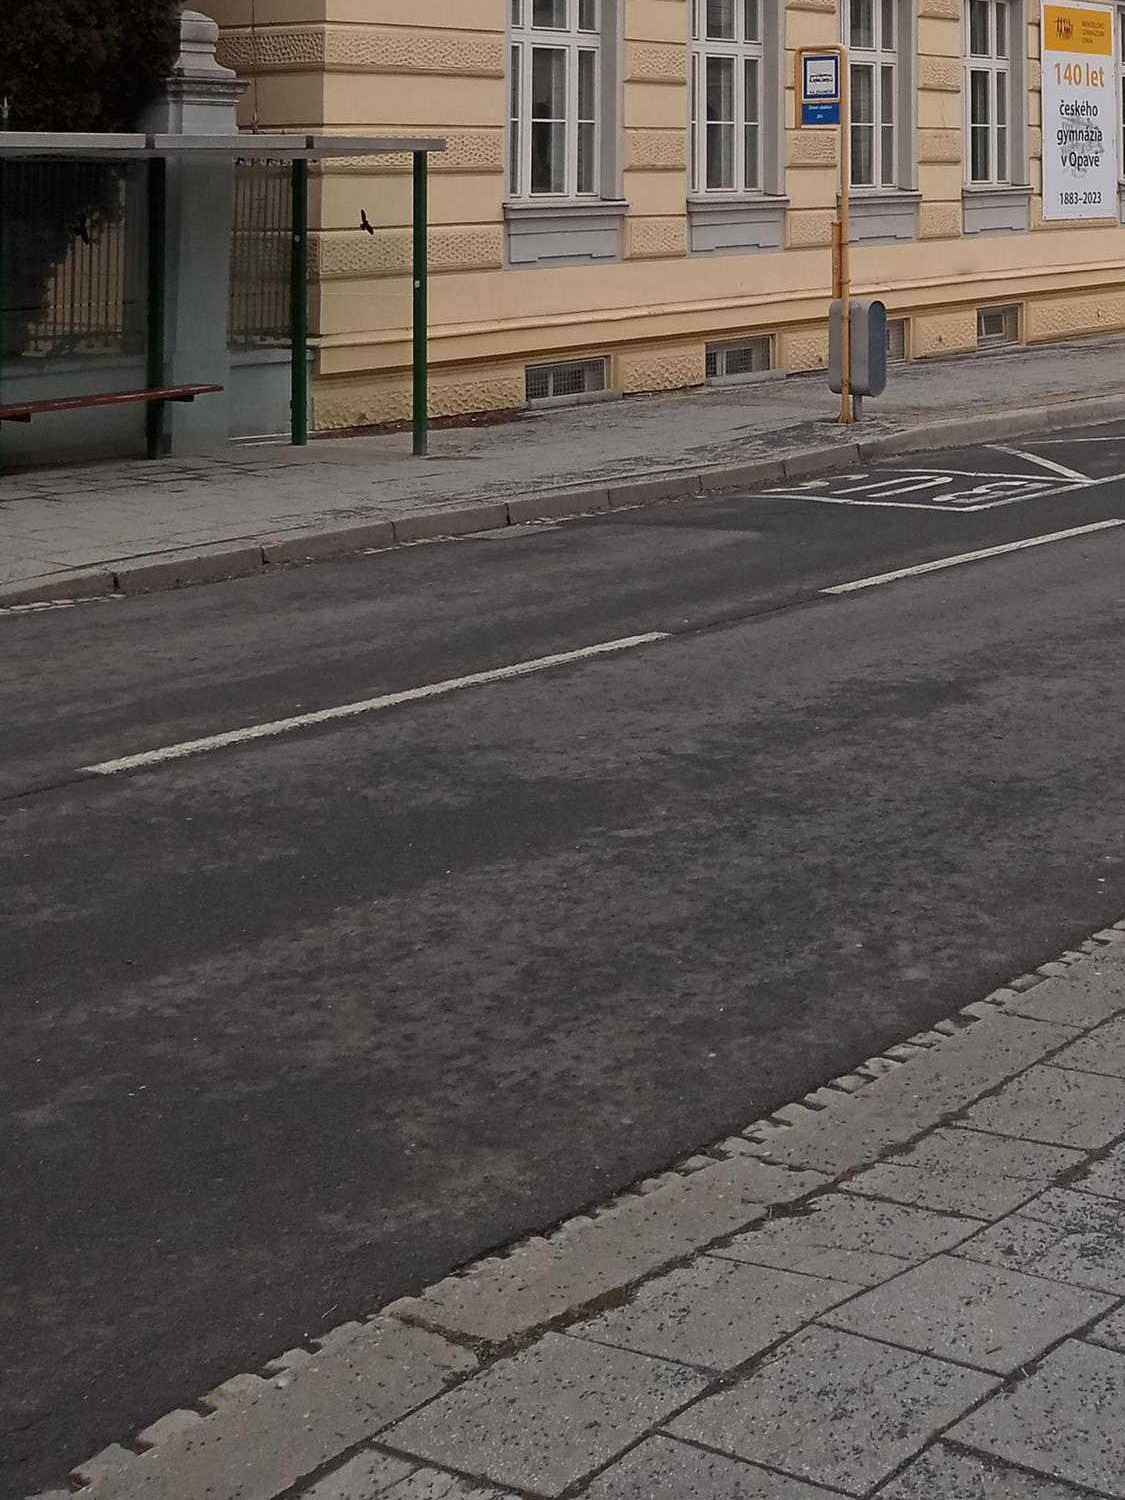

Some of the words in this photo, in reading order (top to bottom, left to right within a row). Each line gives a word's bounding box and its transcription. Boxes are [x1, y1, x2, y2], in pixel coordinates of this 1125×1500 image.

[1055, 62, 1082, 86] 140
[1086, 63, 1105, 87] let
[1059, 100, 1098, 117] českého
[1056, 126, 1103, 145] gymnázia
[1061, 156, 1067, 167] v
[1069, 152, 1100, 171] Opavě
[761, 474, 1053, 503] BUS
